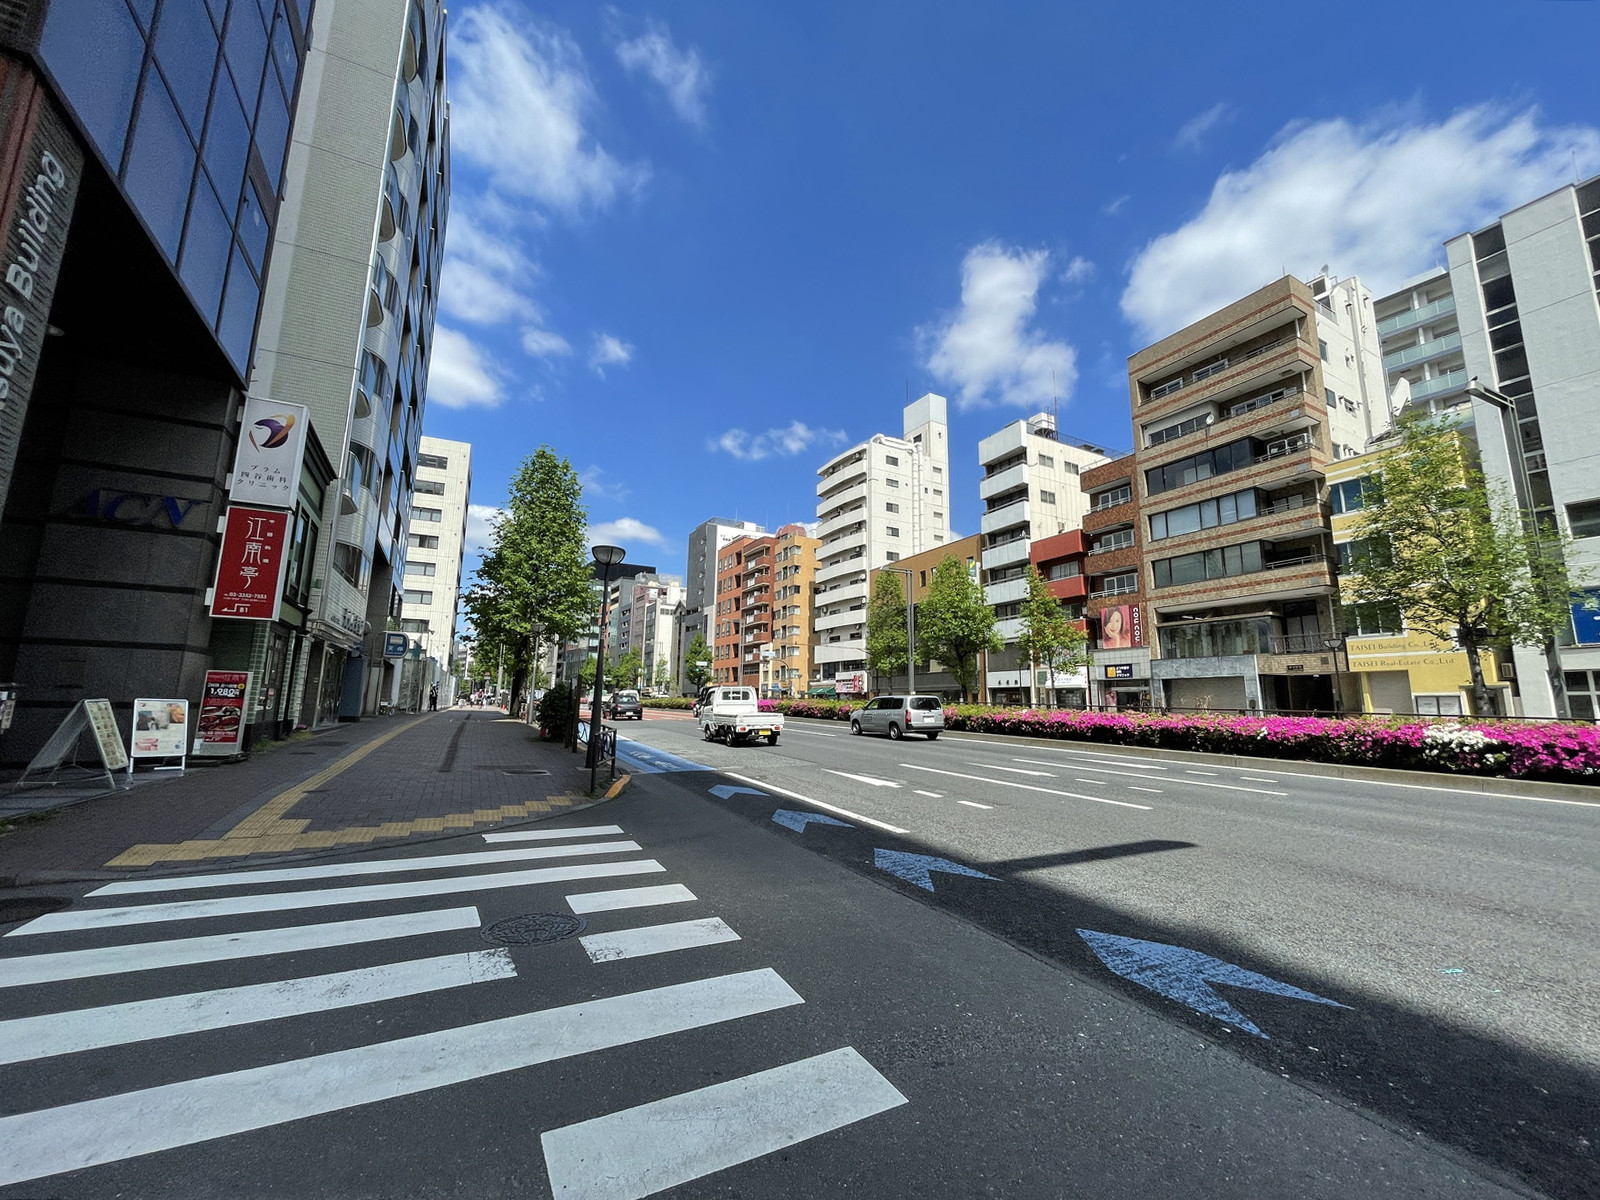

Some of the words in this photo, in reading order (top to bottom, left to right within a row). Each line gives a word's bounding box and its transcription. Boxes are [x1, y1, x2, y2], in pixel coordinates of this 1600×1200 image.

[6, 151, 65, 299] Building
[237, 478, 289, 491] クリニック
[240, 516, 267, 590] 江南亭
[1350, 643, 1377, 651] TAISEI
[1353, 660, 1378, 668] TAISEI
